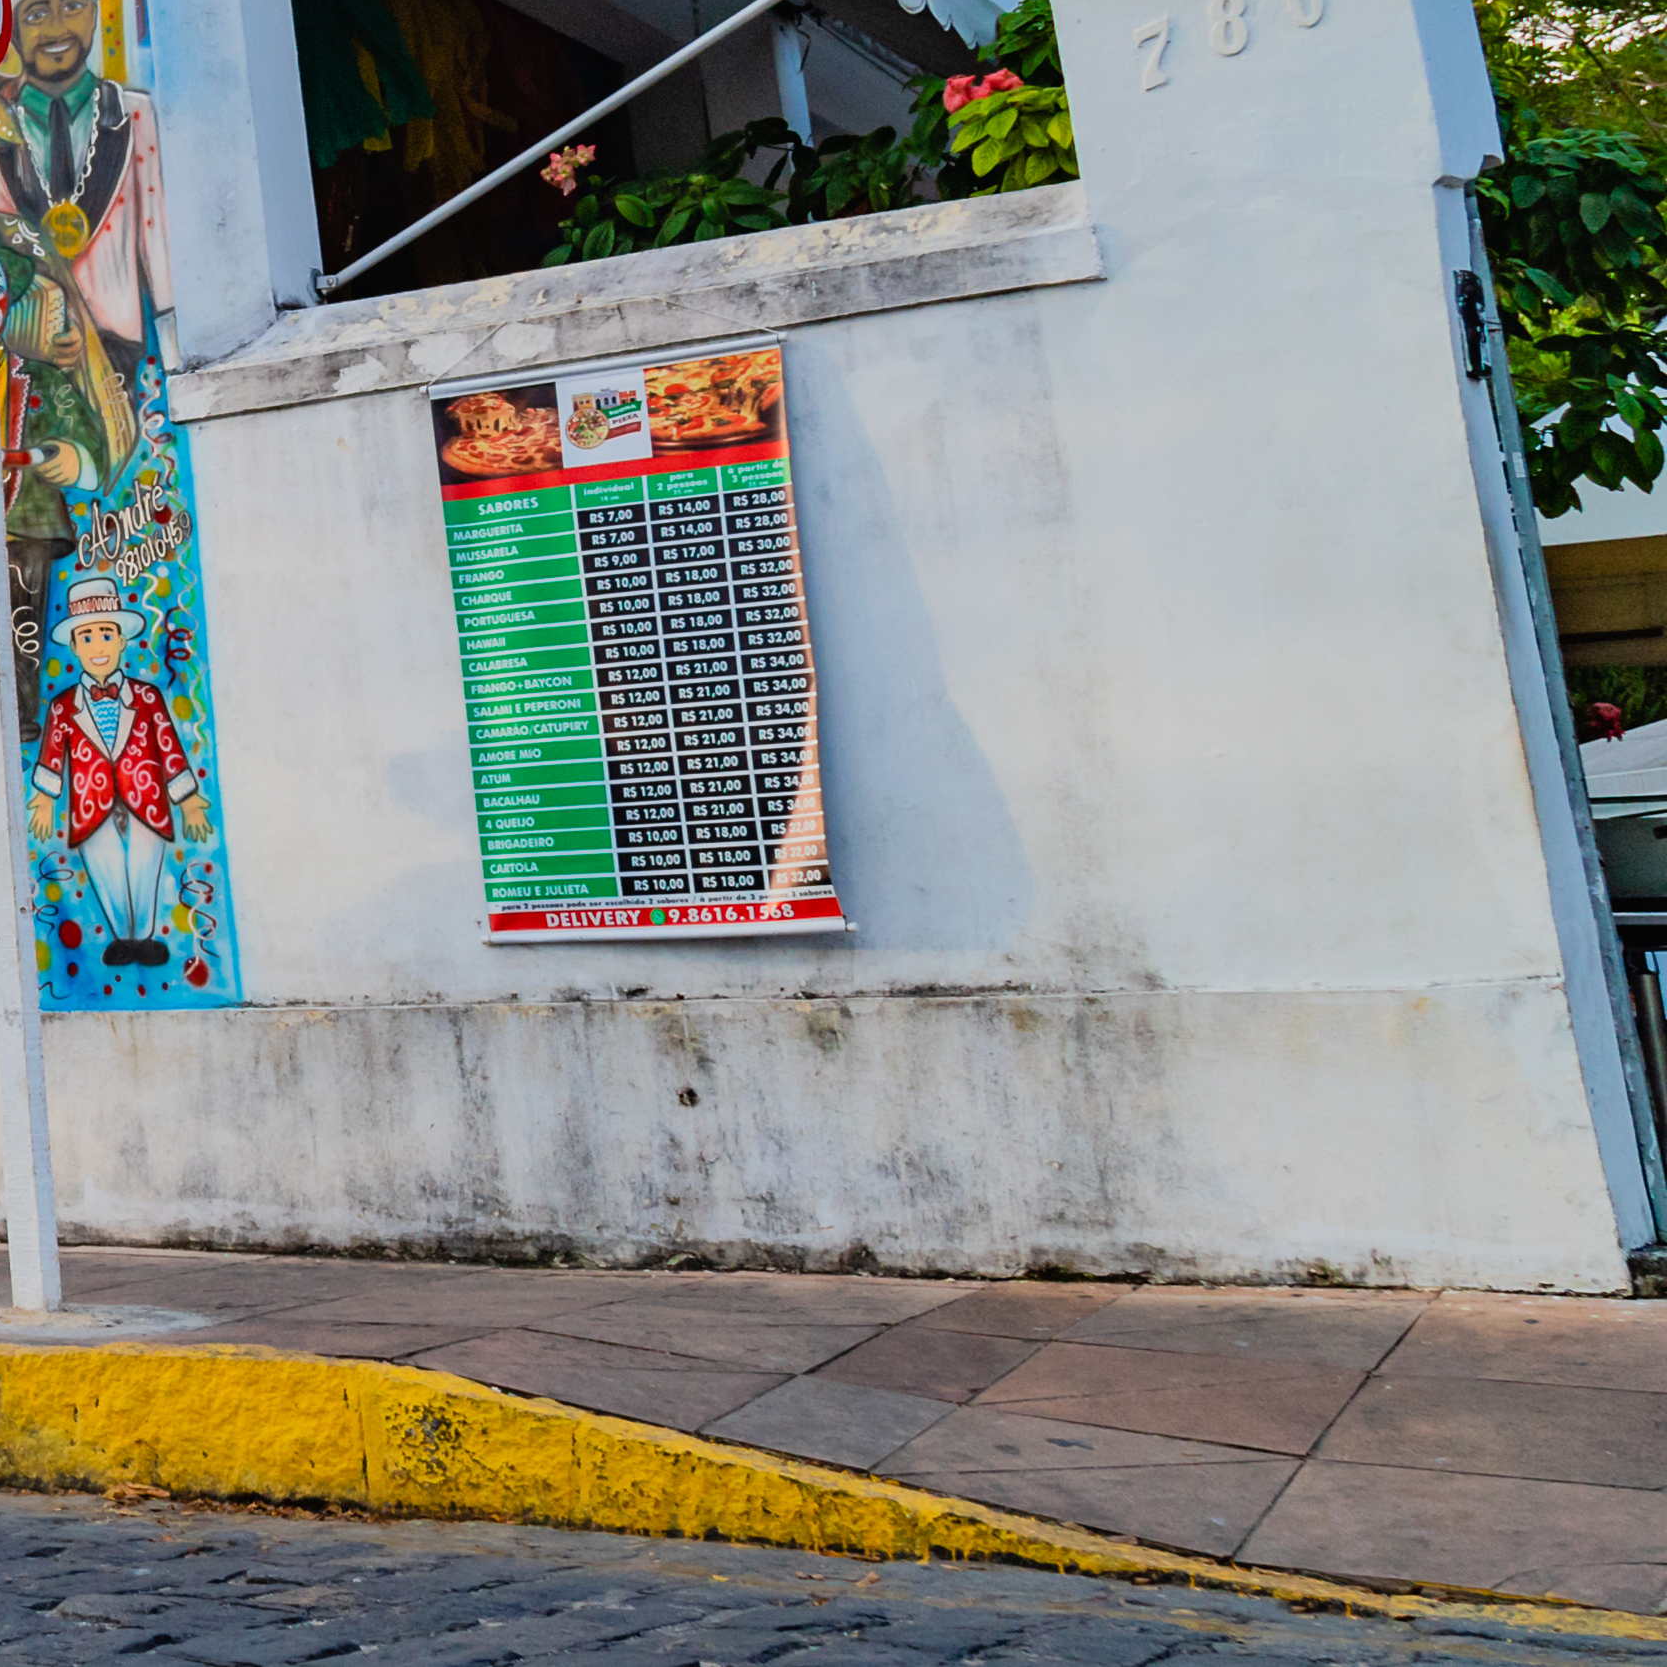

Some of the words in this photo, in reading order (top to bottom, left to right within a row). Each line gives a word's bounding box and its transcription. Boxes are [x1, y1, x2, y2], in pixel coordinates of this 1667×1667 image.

[612, 413, 638, 424] PIZZA
[669, 471, 694, 482] para
[738, 463, 769, 474] partir
[742, 470, 783, 483] pessoas
[583, 482, 634, 496] individual
[657, 483, 663, 491] 2
[667, 478, 708, 491] pessoas
[453, 524, 523, 541] MARGUERITA
[590, 512, 604, 523] R$
[607, 509, 632, 522] 7,00
[659, 504, 673, 515] R$
[678, 500, 710, 513] 14,00
[733, 495, 748, 506] R$
[752, 490, 786, 504] 28,00
[478, 496, 539, 515] SABORES
[78, 473, 164, 568] André
[456, 546, 518, 562] MUSSARELA
[592, 534, 606, 545] R$
[610, 531, 635, 544] 7,00
[661, 526, 675, 537] R$
[680, 522, 712, 535] 14,00
[736, 517, 751, 528] R$
[754, 512, 789, 526] 28,00
[459, 570, 504, 584] FRANGO
[594, 556, 609, 567] R$
[612, 553, 637, 566] 9,00
[663, 548, 678, 560] R$
[682, 545, 715, 558] 17,00
[738, 540, 753, 552] R$
[757, 536, 791, 550] 30,00
[461, 591, 512, 606] CHARQUE
[597, 579, 611, 590] R$
[615, 576, 647, 588] 10,00
[666, 572, 680, 582] R$
[685, 568, 717, 581] 18,00
[741, 564, 756, 575] R$
[760, 559, 794, 573] 32,00
[464, 610, 535, 627] PORTUGUESA
[600, 602, 614, 613] R$
[618, 598, 649, 611] 10,00
[668, 594, 683, 606] R$
[687, 591, 720, 604] 18,00
[743, 587, 758, 598] R$
[762, 582, 796, 596] 32,00
[467, 637, 506, 650] HAWAII
[603, 624, 616, 636] R$
[620, 621, 652, 634] 10,00
[671, 617, 685, 629] R$
[690, 614, 722, 627] 18,00
[746, 610, 761, 621] R$
[765, 606, 799, 620] 32,00
[469, 657, 528, 672] CALABRESA
[605, 647, 619, 658] R$
[623, 644, 654, 657] 10,00
[673, 640, 688, 652] R$
[692, 638, 725, 650] 18,00
[748, 634, 763, 645] R$
[767, 629, 802, 643] 32,00
[608, 670, 622, 681] R$
[626, 667, 657, 680] 12,00
[676, 664, 690, 675] R$
[694, 661, 727, 674] 21,00
[751, 657, 766, 668] R$
[770, 654, 804, 667] 34,00
[473, 704, 512, 717] SALAMI
[516, 703, 521, 713] E
[524, 699, 581, 713] PEPERONI
[611, 693, 625, 704] R$
[629, 691, 659, 703] 12,00
[679, 687, 693, 698] R$
[697, 684, 730, 697] 21,00
[753, 681, 769, 692] R$
[773, 678, 807, 691] 34,00
[614, 716, 628, 728] R$
[631, 714, 663, 726] 12,00
[681, 710, 696, 722] R$
[699, 708, 733, 721] 21,00
[756, 704, 771, 716] R$
[775, 701, 810, 715] 34,00
[478, 750, 516, 763] AMORE
[519, 748, 541, 758] MIO
[617, 740, 631, 751] R$
[635, 737, 665, 750] 12,00
[684, 734, 699, 746] R$
[702, 732, 735, 745] 21,00
[759, 728, 774, 740] R$
[778, 725, 812, 739] 34,00
[481, 773, 511, 784] ATUM
[620, 763, 634, 774] R$
[637, 761, 668, 773] 12,00
[687, 758, 702, 769] R$
[705, 756, 738, 768] 21,00
[483, 794, 540, 807] BACALHAU
[623, 786, 637, 798] R$
[641, 784, 671, 797] 12,00
[690, 782, 705, 793] R$
[708, 780, 741, 792] 21,00
[485, 820, 492, 829] 4
[496, 817, 535, 829] QUEIJO
[626, 809, 640, 820] R$
[643, 807, 674, 820] 12,00
[693, 805, 707, 816] R$
[711, 803, 744, 816] 21,00
[488, 837, 554, 850] BRIGADEIRO
[629, 832, 643, 842] R$
[647, 830, 677, 842] 10,00
[696, 827, 711, 839] R$
[715, 826, 747, 838] 18,00
[490, 862, 538, 874] CARTOLA
[631, 856, 646, 867] R$
[649, 854, 680, 867] 10,00
[699, 852, 714, 863] R$
[718, 850, 751, 863] 18,00
[492, 888, 531, 898] ROMEU
[535, 886, 541, 896] E
[545, 884, 589, 896] JULIETA
[634, 880, 649, 891] R$
[653, 878, 684, 891] 10,00
[702, 876, 717, 888] R$
[721, 875, 754, 888] 18,00
[546, 910, 640, 928] DELIVERY
[668, 904, 795, 923] 9.8616.1568
